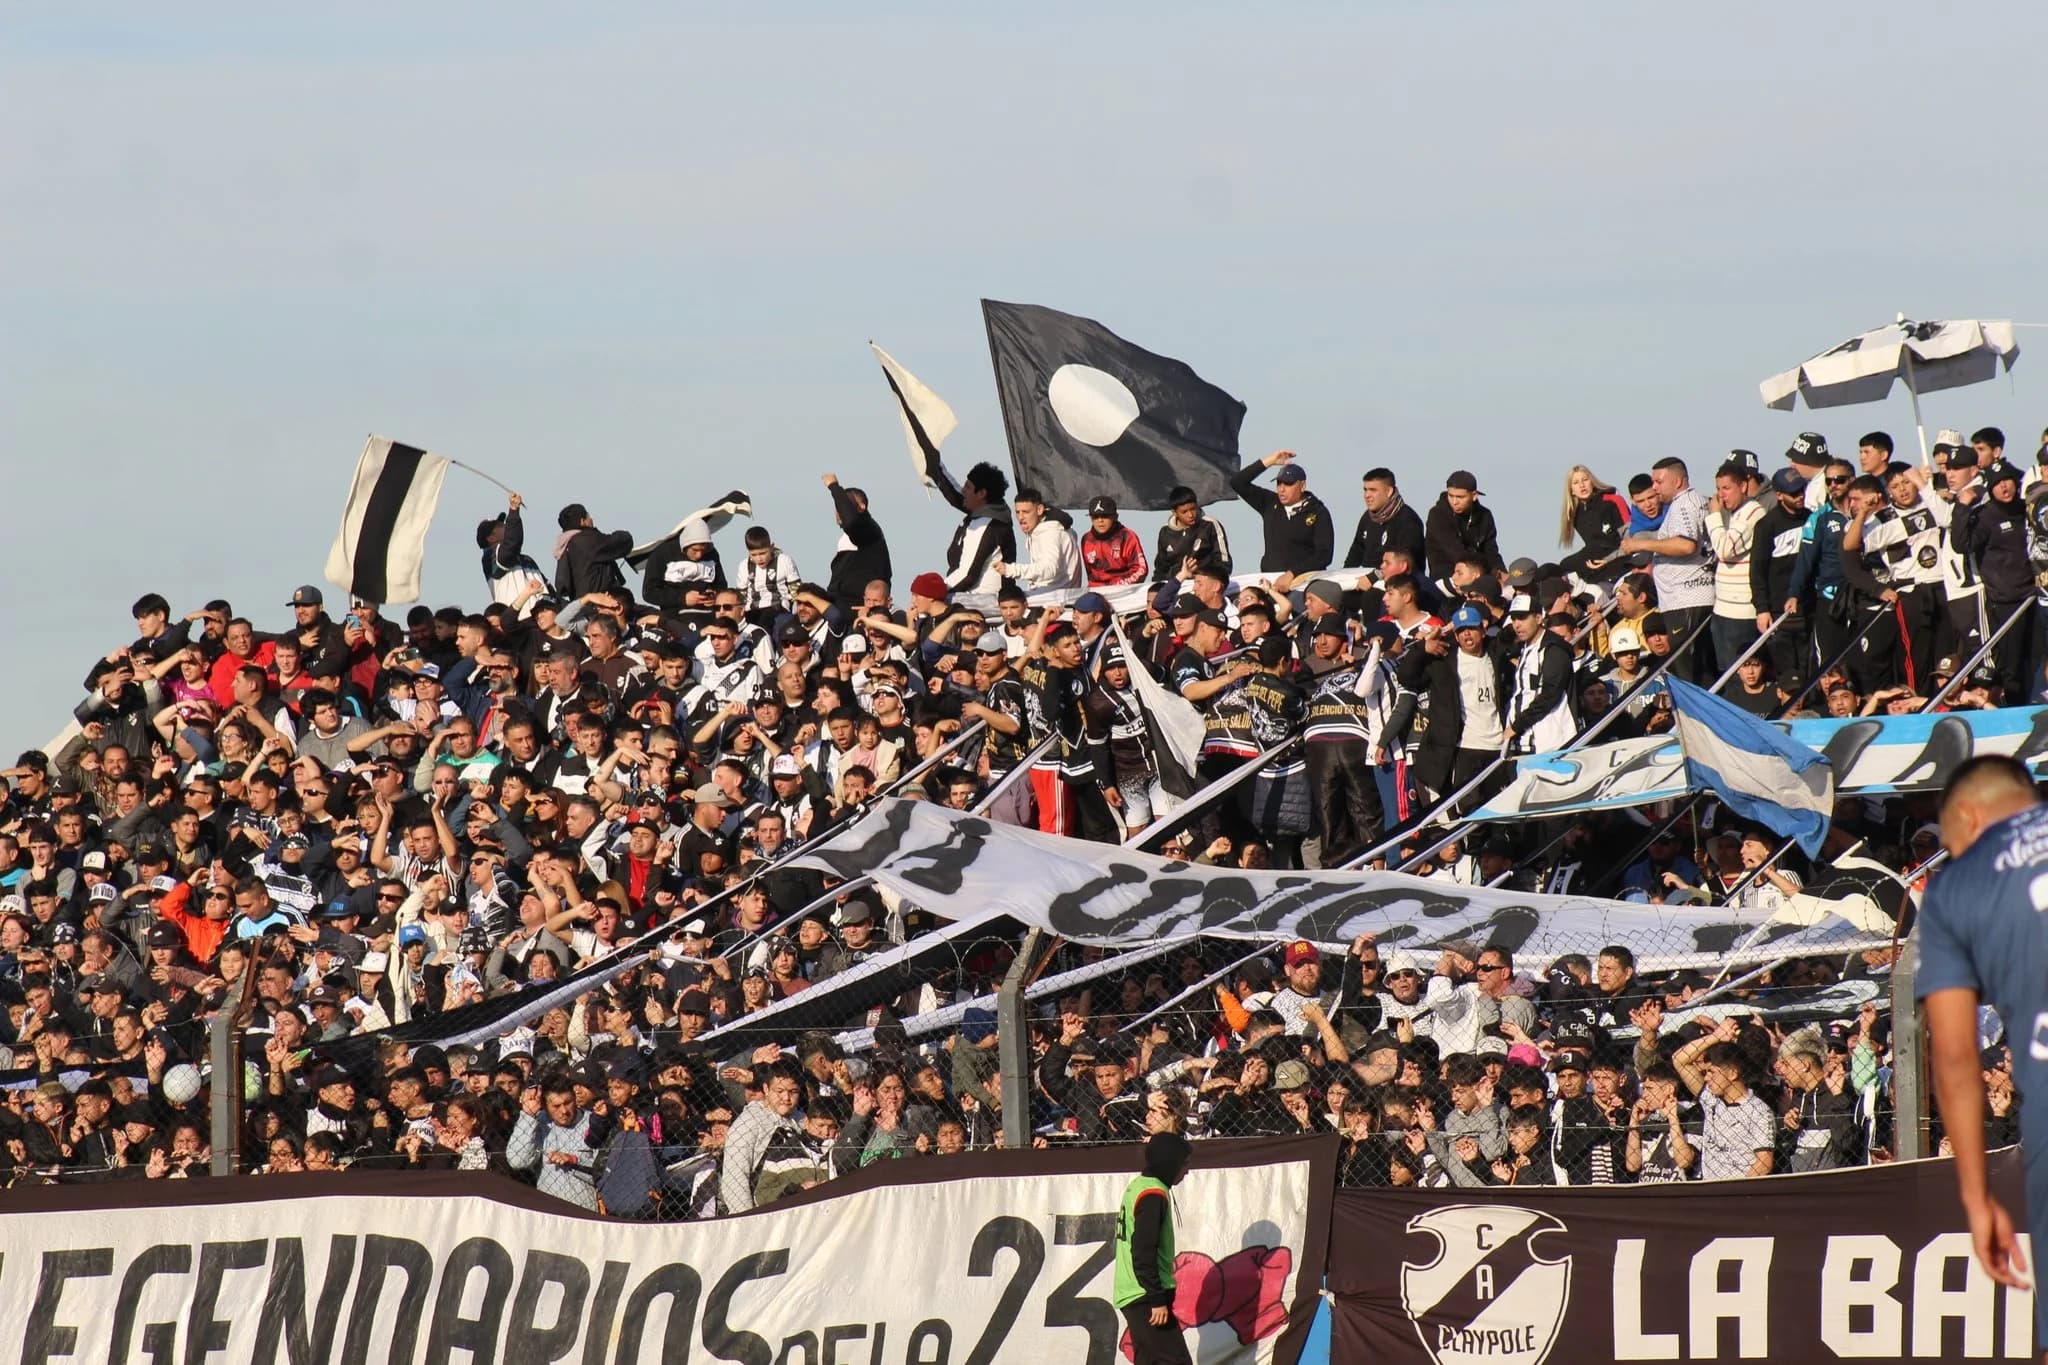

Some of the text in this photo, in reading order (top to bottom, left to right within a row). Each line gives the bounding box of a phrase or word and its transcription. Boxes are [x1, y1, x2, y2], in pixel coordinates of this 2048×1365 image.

[1478, 686, 1490, 703] 24
[1476, 1223, 1493, 1250] C
[1475, 1264, 1494, 1300] A
[1613, 1237, 1775, 1359] LA
[0, 1234, 789, 1365] EGENDARIOS
[1438, 1324, 1536, 1355] CLAYPOLE
